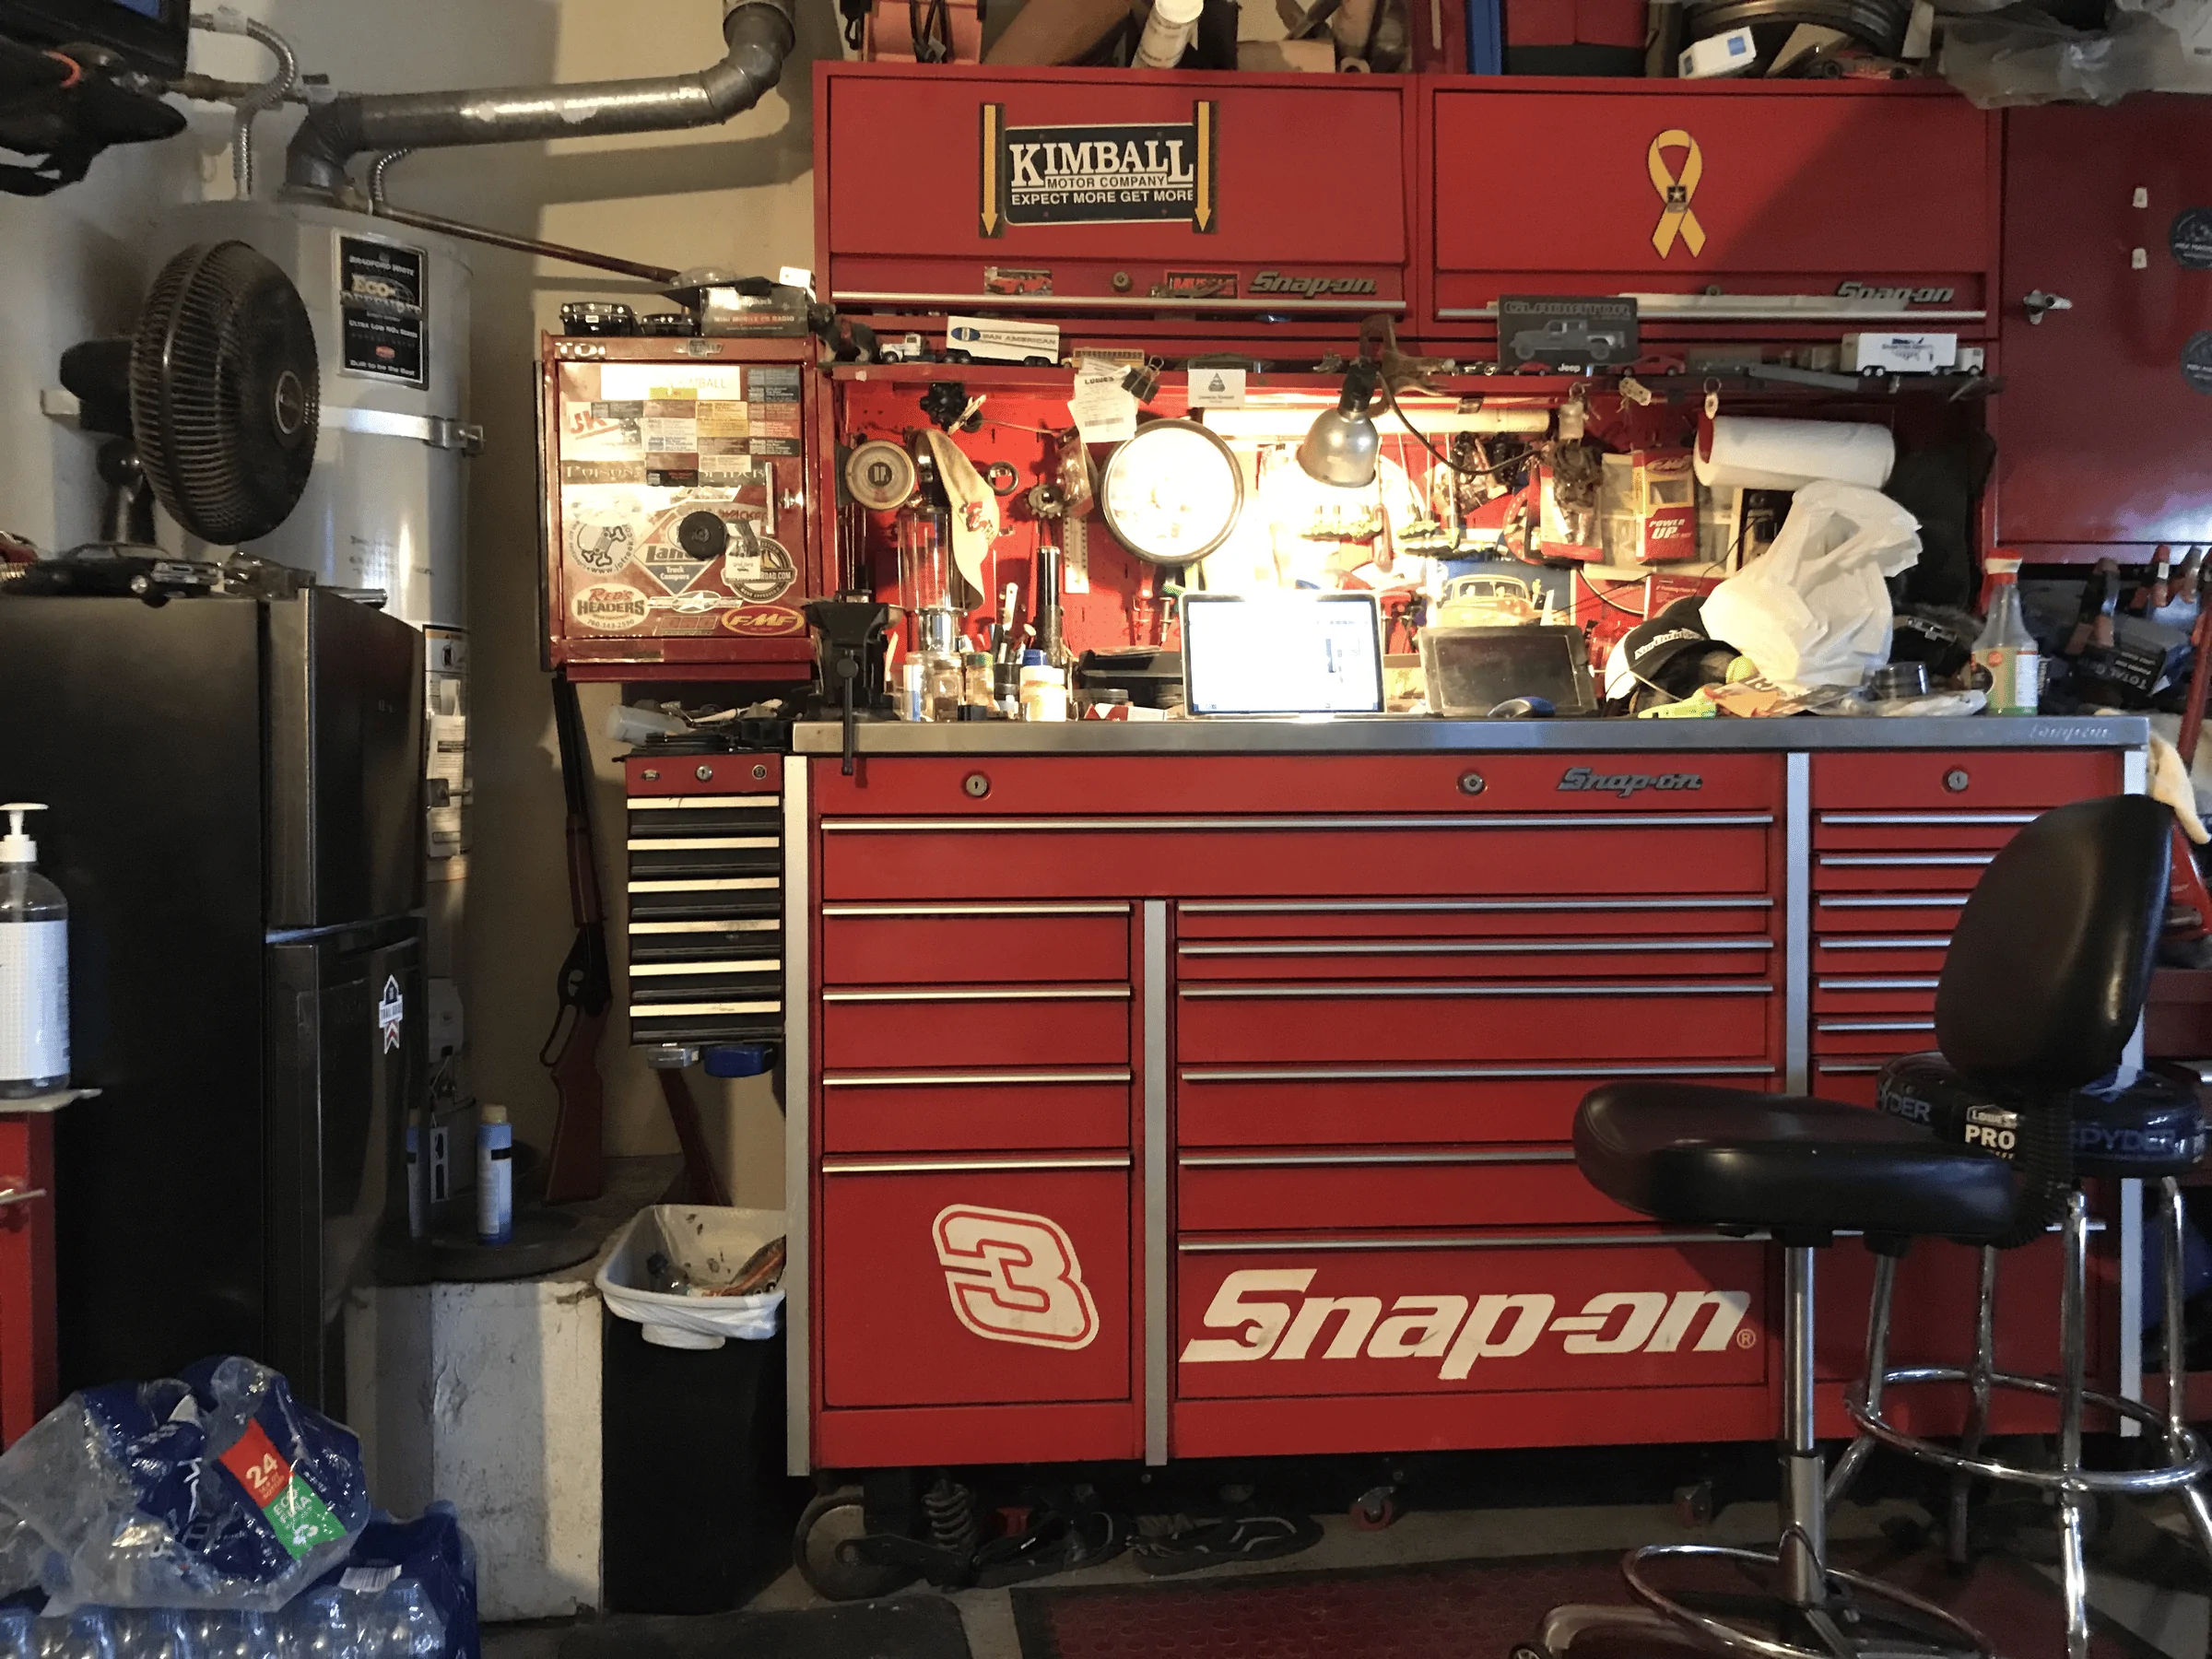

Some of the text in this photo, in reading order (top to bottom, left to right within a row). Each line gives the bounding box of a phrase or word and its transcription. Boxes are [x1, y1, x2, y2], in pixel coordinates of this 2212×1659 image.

[1009, 140, 1194, 187] KIMBALL
[1048, 172, 1165, 189] MOTOR COMPANY
[1012, 189, 1193, 206] EXPECT MORE GET MORE
[1006, 336, 1056, 346] AMERICAN
[1558, 363, 1581, 373] Jeep
[1649, 519, 1686, 528] POWER
[1651, 527, 1677, 539] UP
[577, 599, 644, 617] HEADERS
[1558, 767, 1703, 798] Snap-on
[1965, 1124, 2016, 1150] PRO
[932, 1204, 1100, 1350] 3
[1179, 1268, 1750, 1380] Snap-on
[246, 1453, 277, 1488] 24
